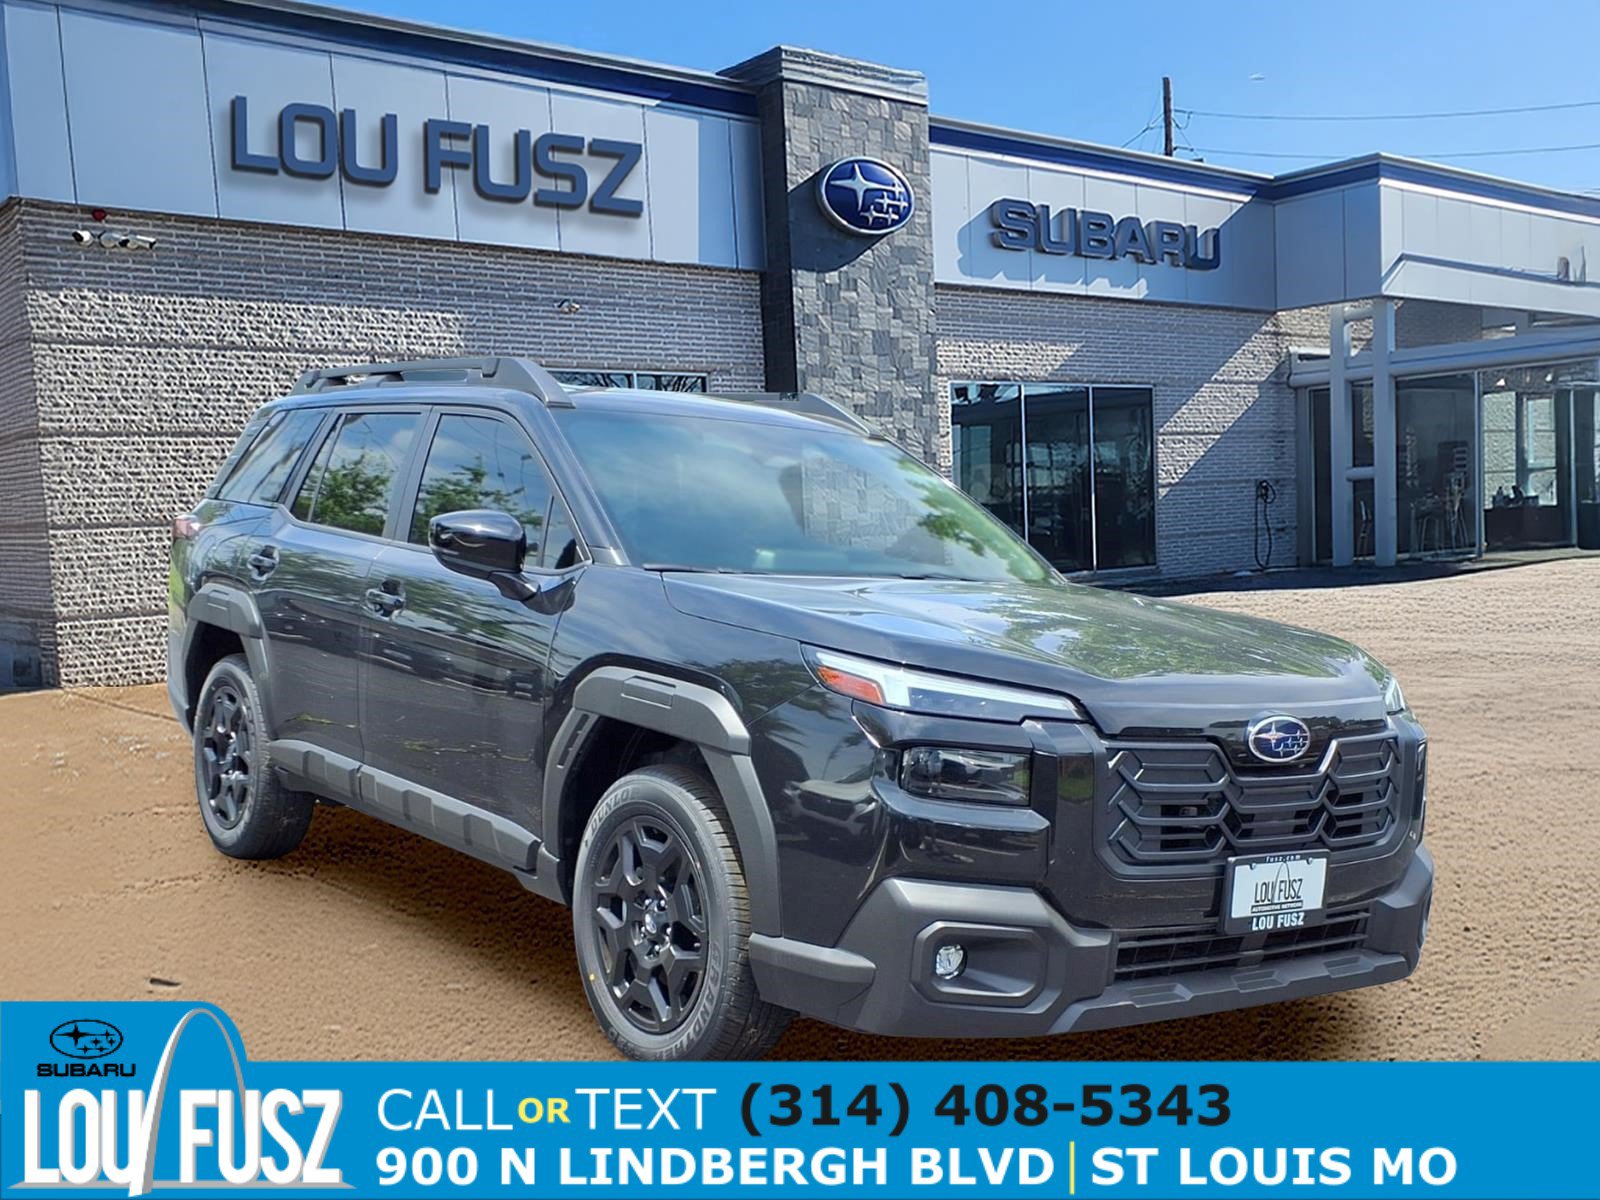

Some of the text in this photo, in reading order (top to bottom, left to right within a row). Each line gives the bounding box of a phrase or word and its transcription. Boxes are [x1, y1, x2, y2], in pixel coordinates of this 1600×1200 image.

[231, 94, 644, 218] LOU FUSZ
[988, 198, 1221, 270] SUBARU
[1265, 854, 1302, 863] fusz.com
[1254, 878, 1304, 903] LOU FUSZ
[1251, 912, 1305, 931] LOU FUSZ
